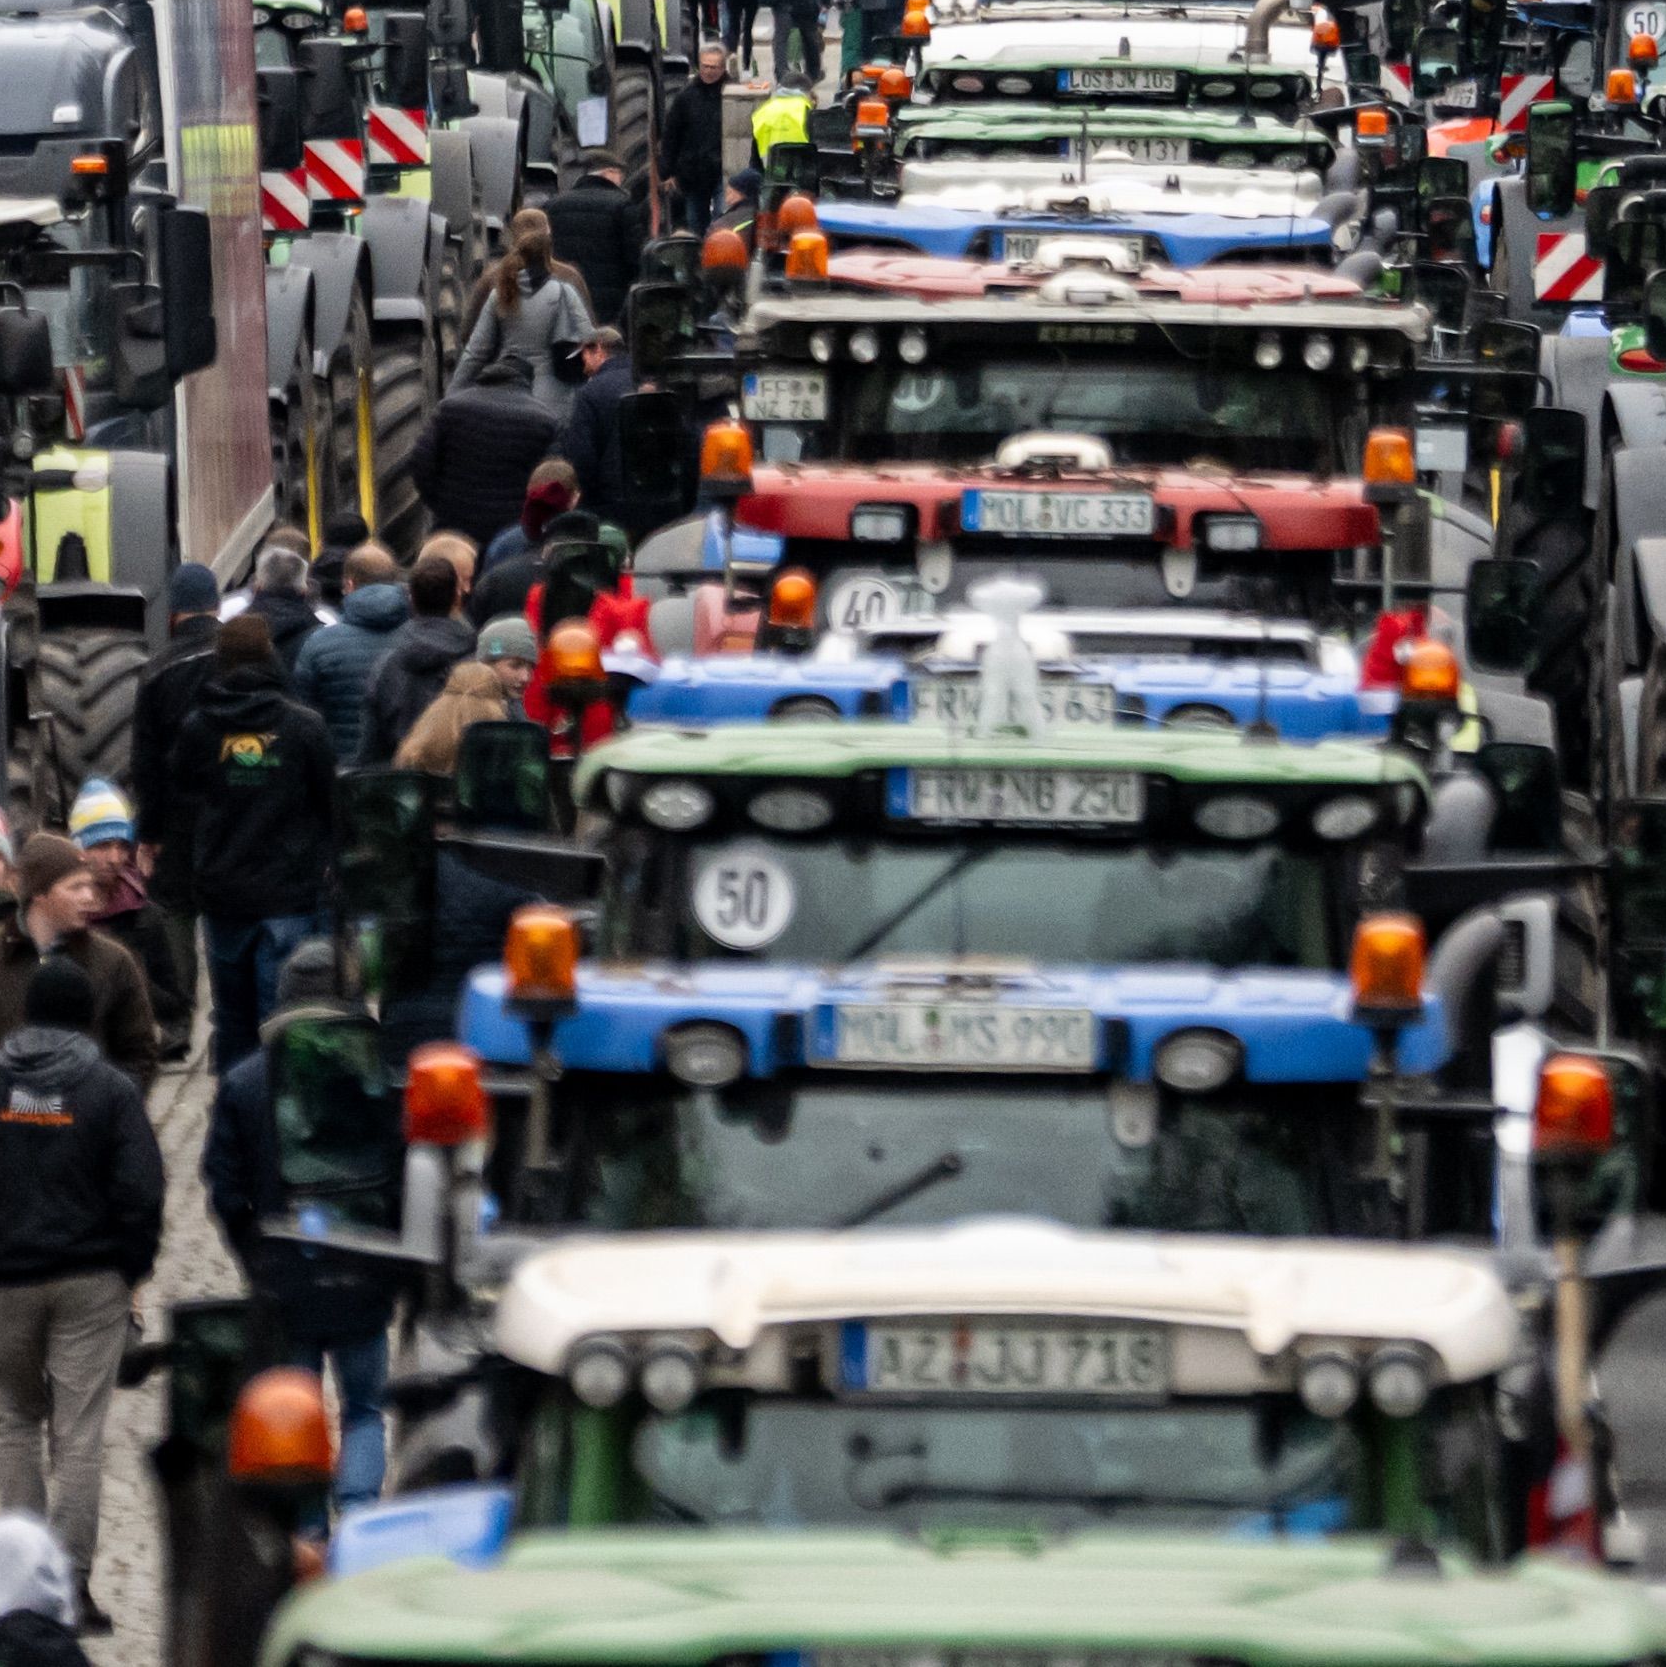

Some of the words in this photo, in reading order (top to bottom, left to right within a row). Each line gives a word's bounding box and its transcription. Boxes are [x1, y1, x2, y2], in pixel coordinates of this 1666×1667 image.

[1633, 11, 1659, 35] 50
[1070, 69, 1102, 90] LOS
[761, 379, 790, 398] FF
[982, 498, 1034, 529] MOL
[1100, 499, 1148, 529] 333
[841, 589, 887, 629] 40
[716, 869, 771, 931] 50
